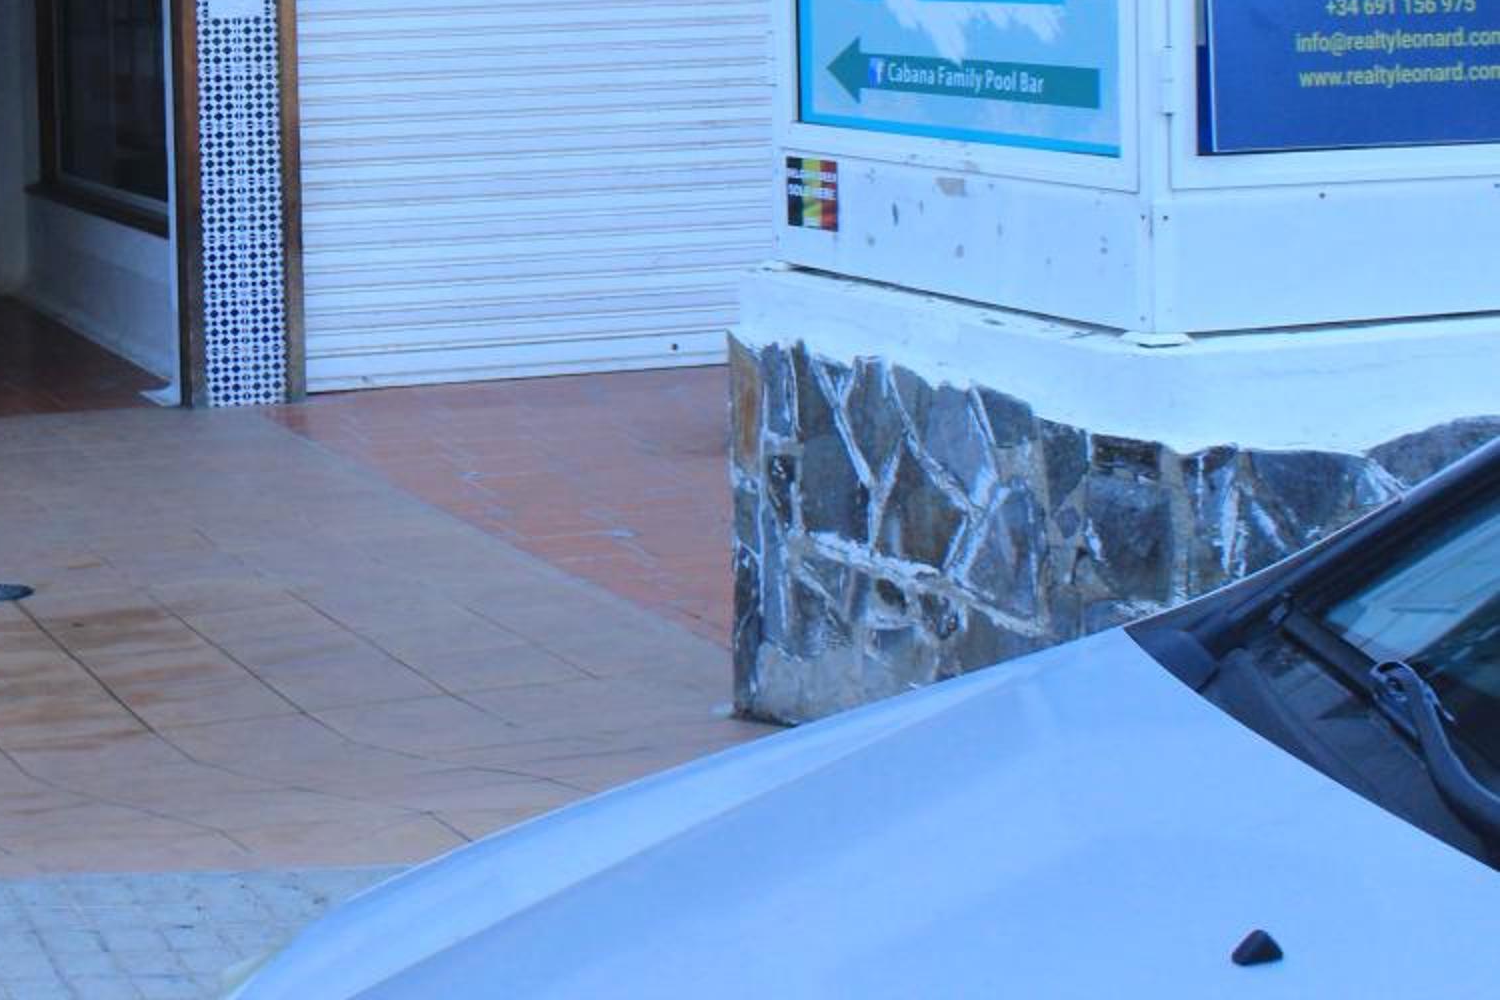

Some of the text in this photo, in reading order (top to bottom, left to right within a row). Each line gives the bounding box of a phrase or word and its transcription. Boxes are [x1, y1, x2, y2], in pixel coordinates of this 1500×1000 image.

[887, 61, 935, 85] Cabana
[937, 65, 982, 93] Family
[986, 69, 1017, 92] Pool
[1020, 72, 1044, 94] Bar
